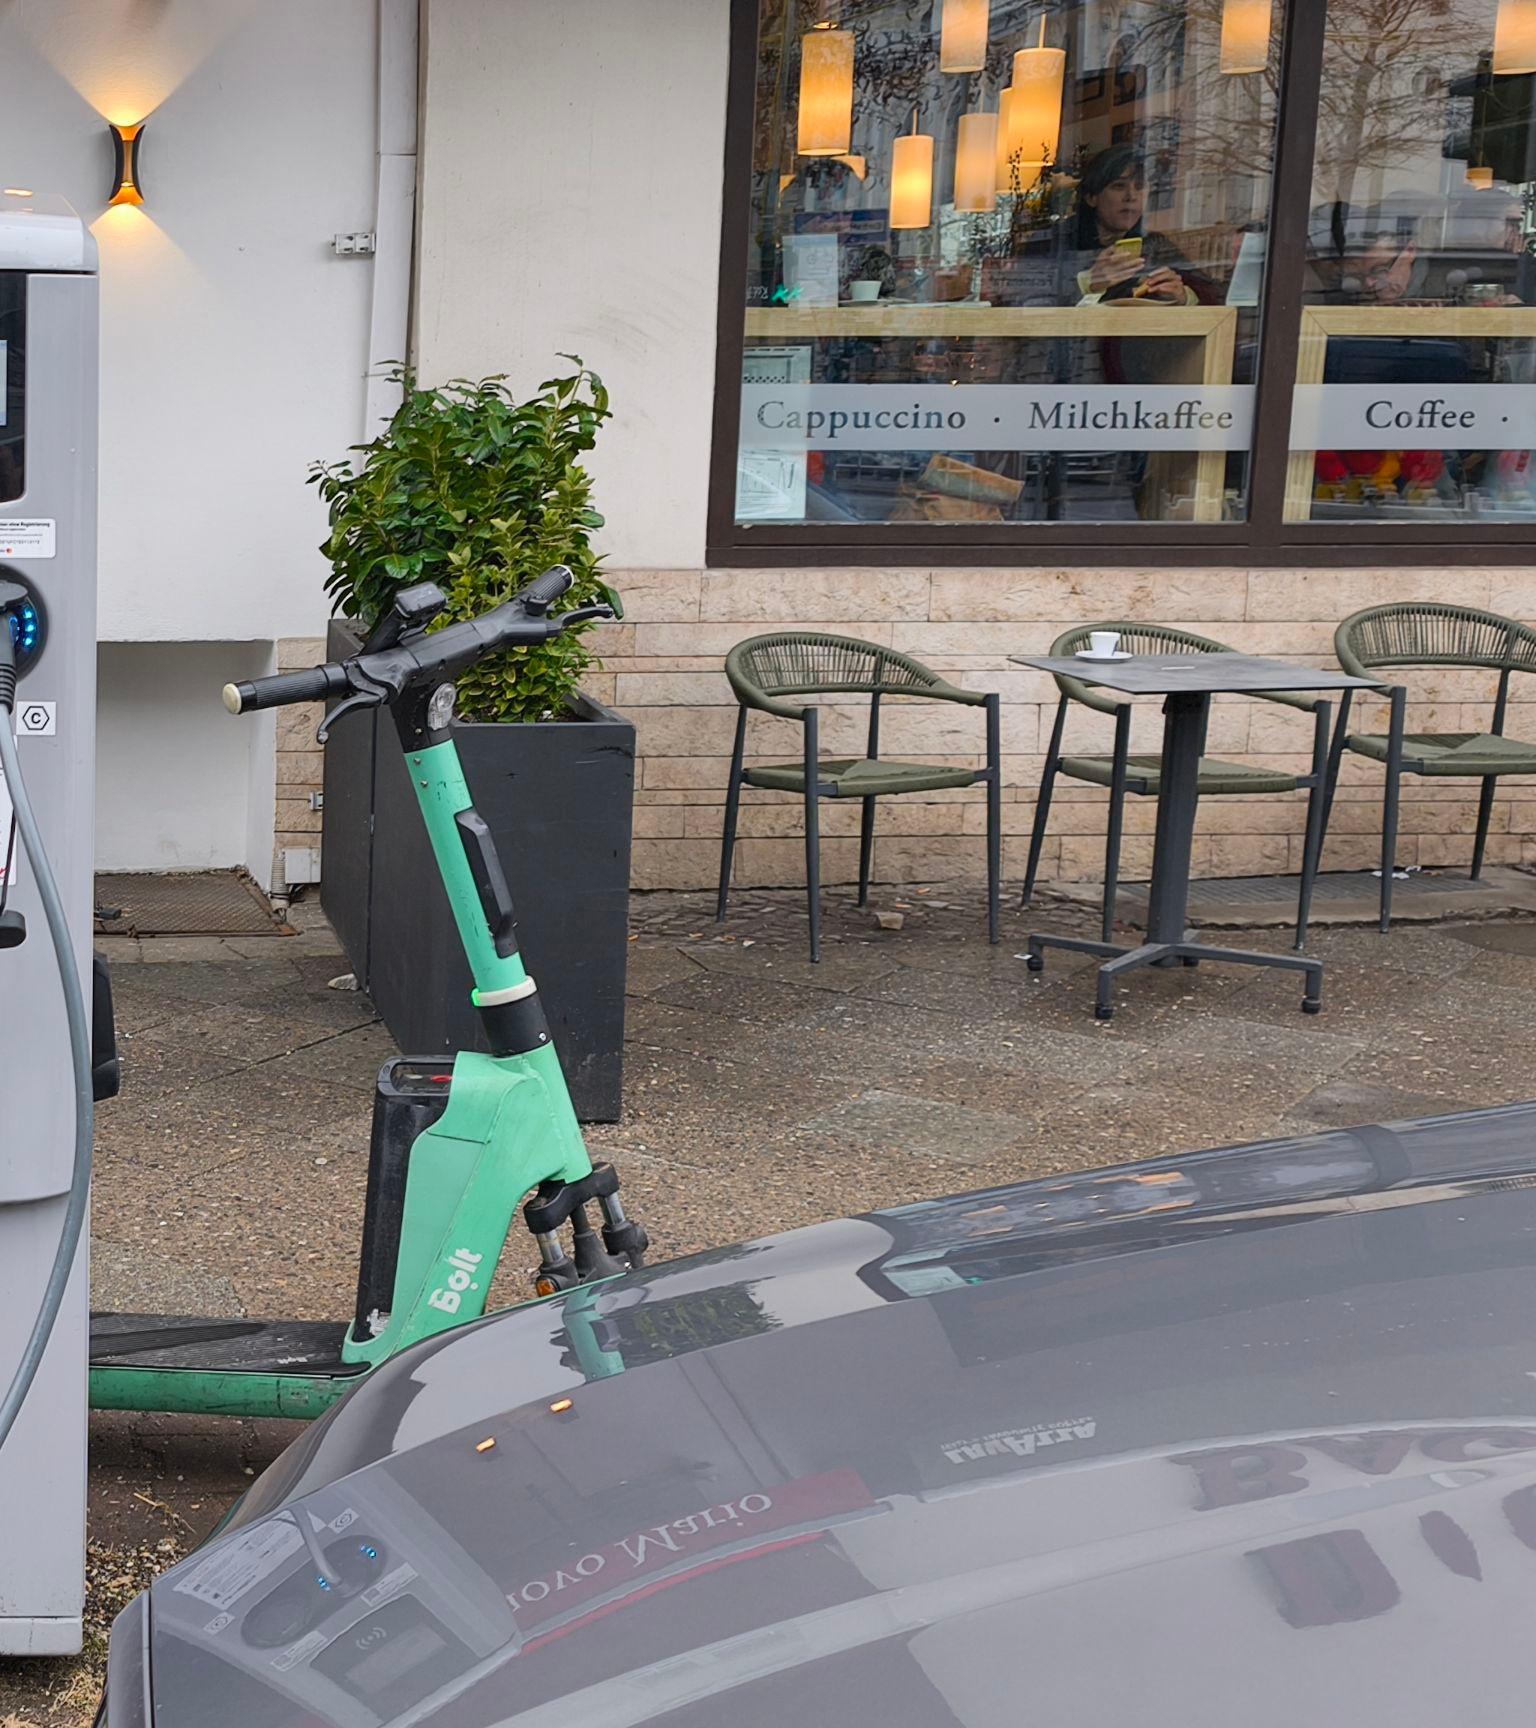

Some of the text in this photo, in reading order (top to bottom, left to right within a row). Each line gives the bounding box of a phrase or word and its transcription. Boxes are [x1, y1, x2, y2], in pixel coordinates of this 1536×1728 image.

[757, 400, 1234, 439] Cappuccino Milchkaffee
[1365, 399, 1476, 429] Coffee
[30, 712, 41, 724] C
[427, 1247, 483, 1314] Bolt
